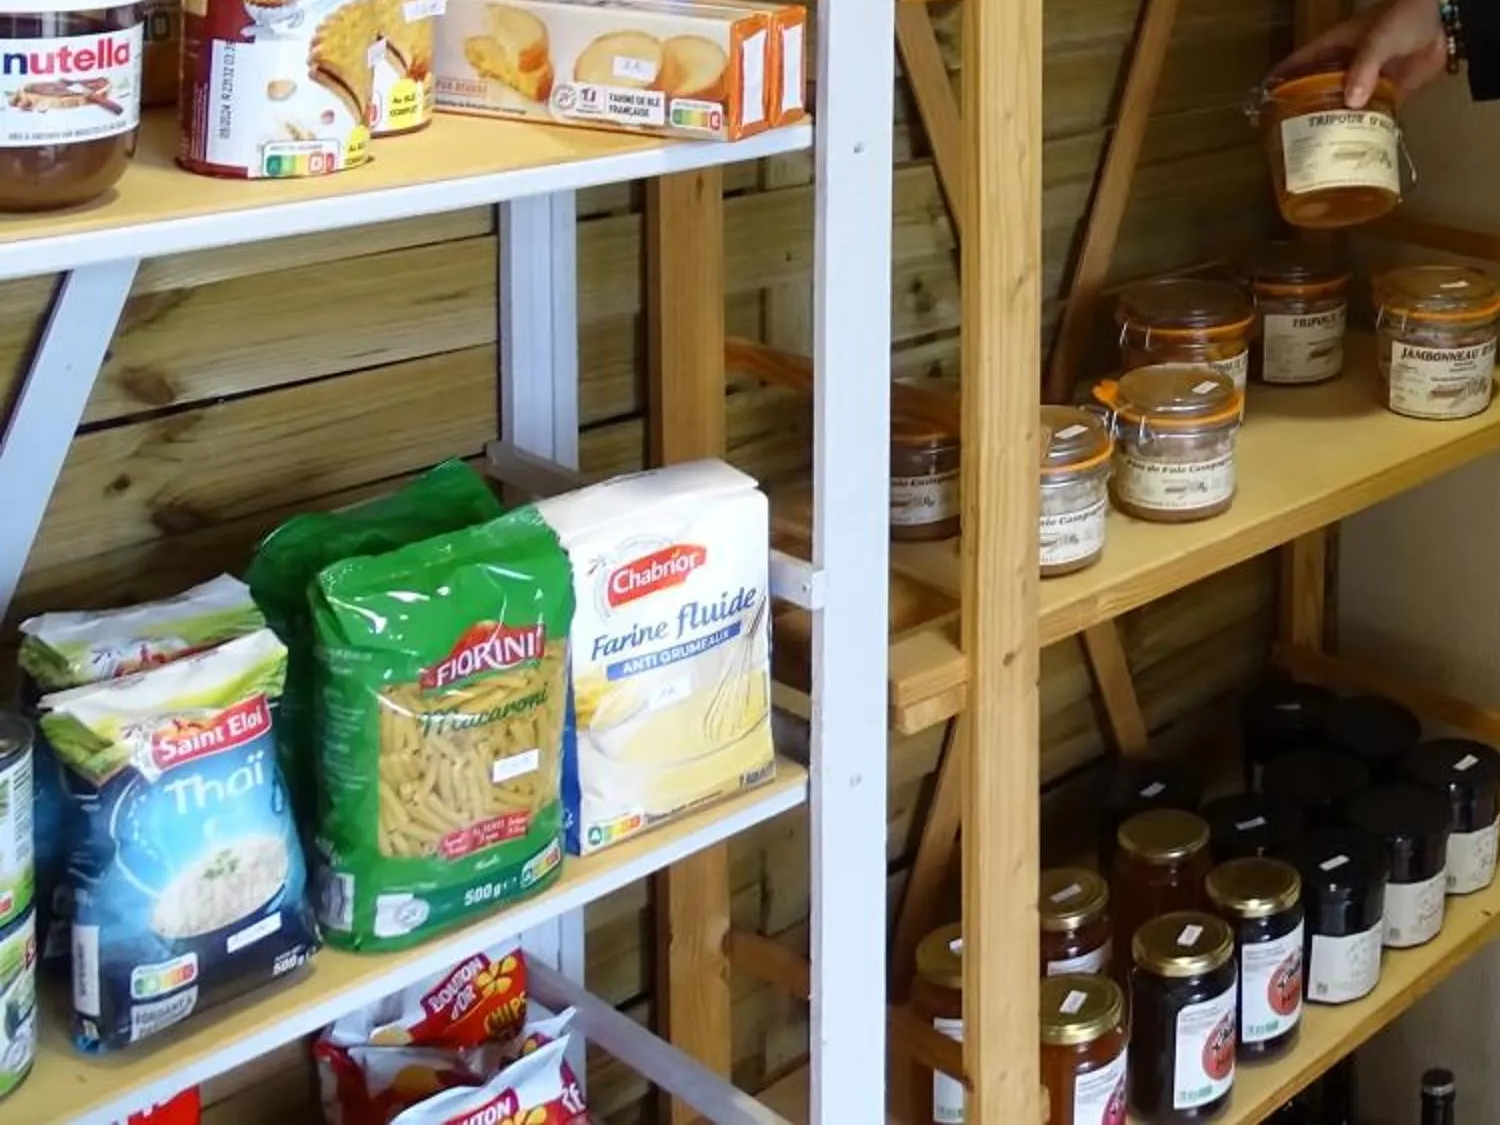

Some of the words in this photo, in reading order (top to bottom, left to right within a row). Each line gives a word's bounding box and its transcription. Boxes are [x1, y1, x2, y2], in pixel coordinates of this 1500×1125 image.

[3, 37, 130, 76] nutella
[1400, 346, 1480, 362] JAMBONNEAU
[612, 550, 702, 594] Chabrior
[591, 621, 668, 662] Farine
[676, 586, 757, 640] fluide
[436, 631, 535, 687] FIORINI
[623, 654, 657, 675] ANTI
[660, 629, 730, 663] GRUMEAUX
[420, 680, 549, 739] Macaroni
[159, 725, 225, 762] Saint
[162, 750, 265, 815] Thaï
[428, 955, 487, 1013] BOUTON
